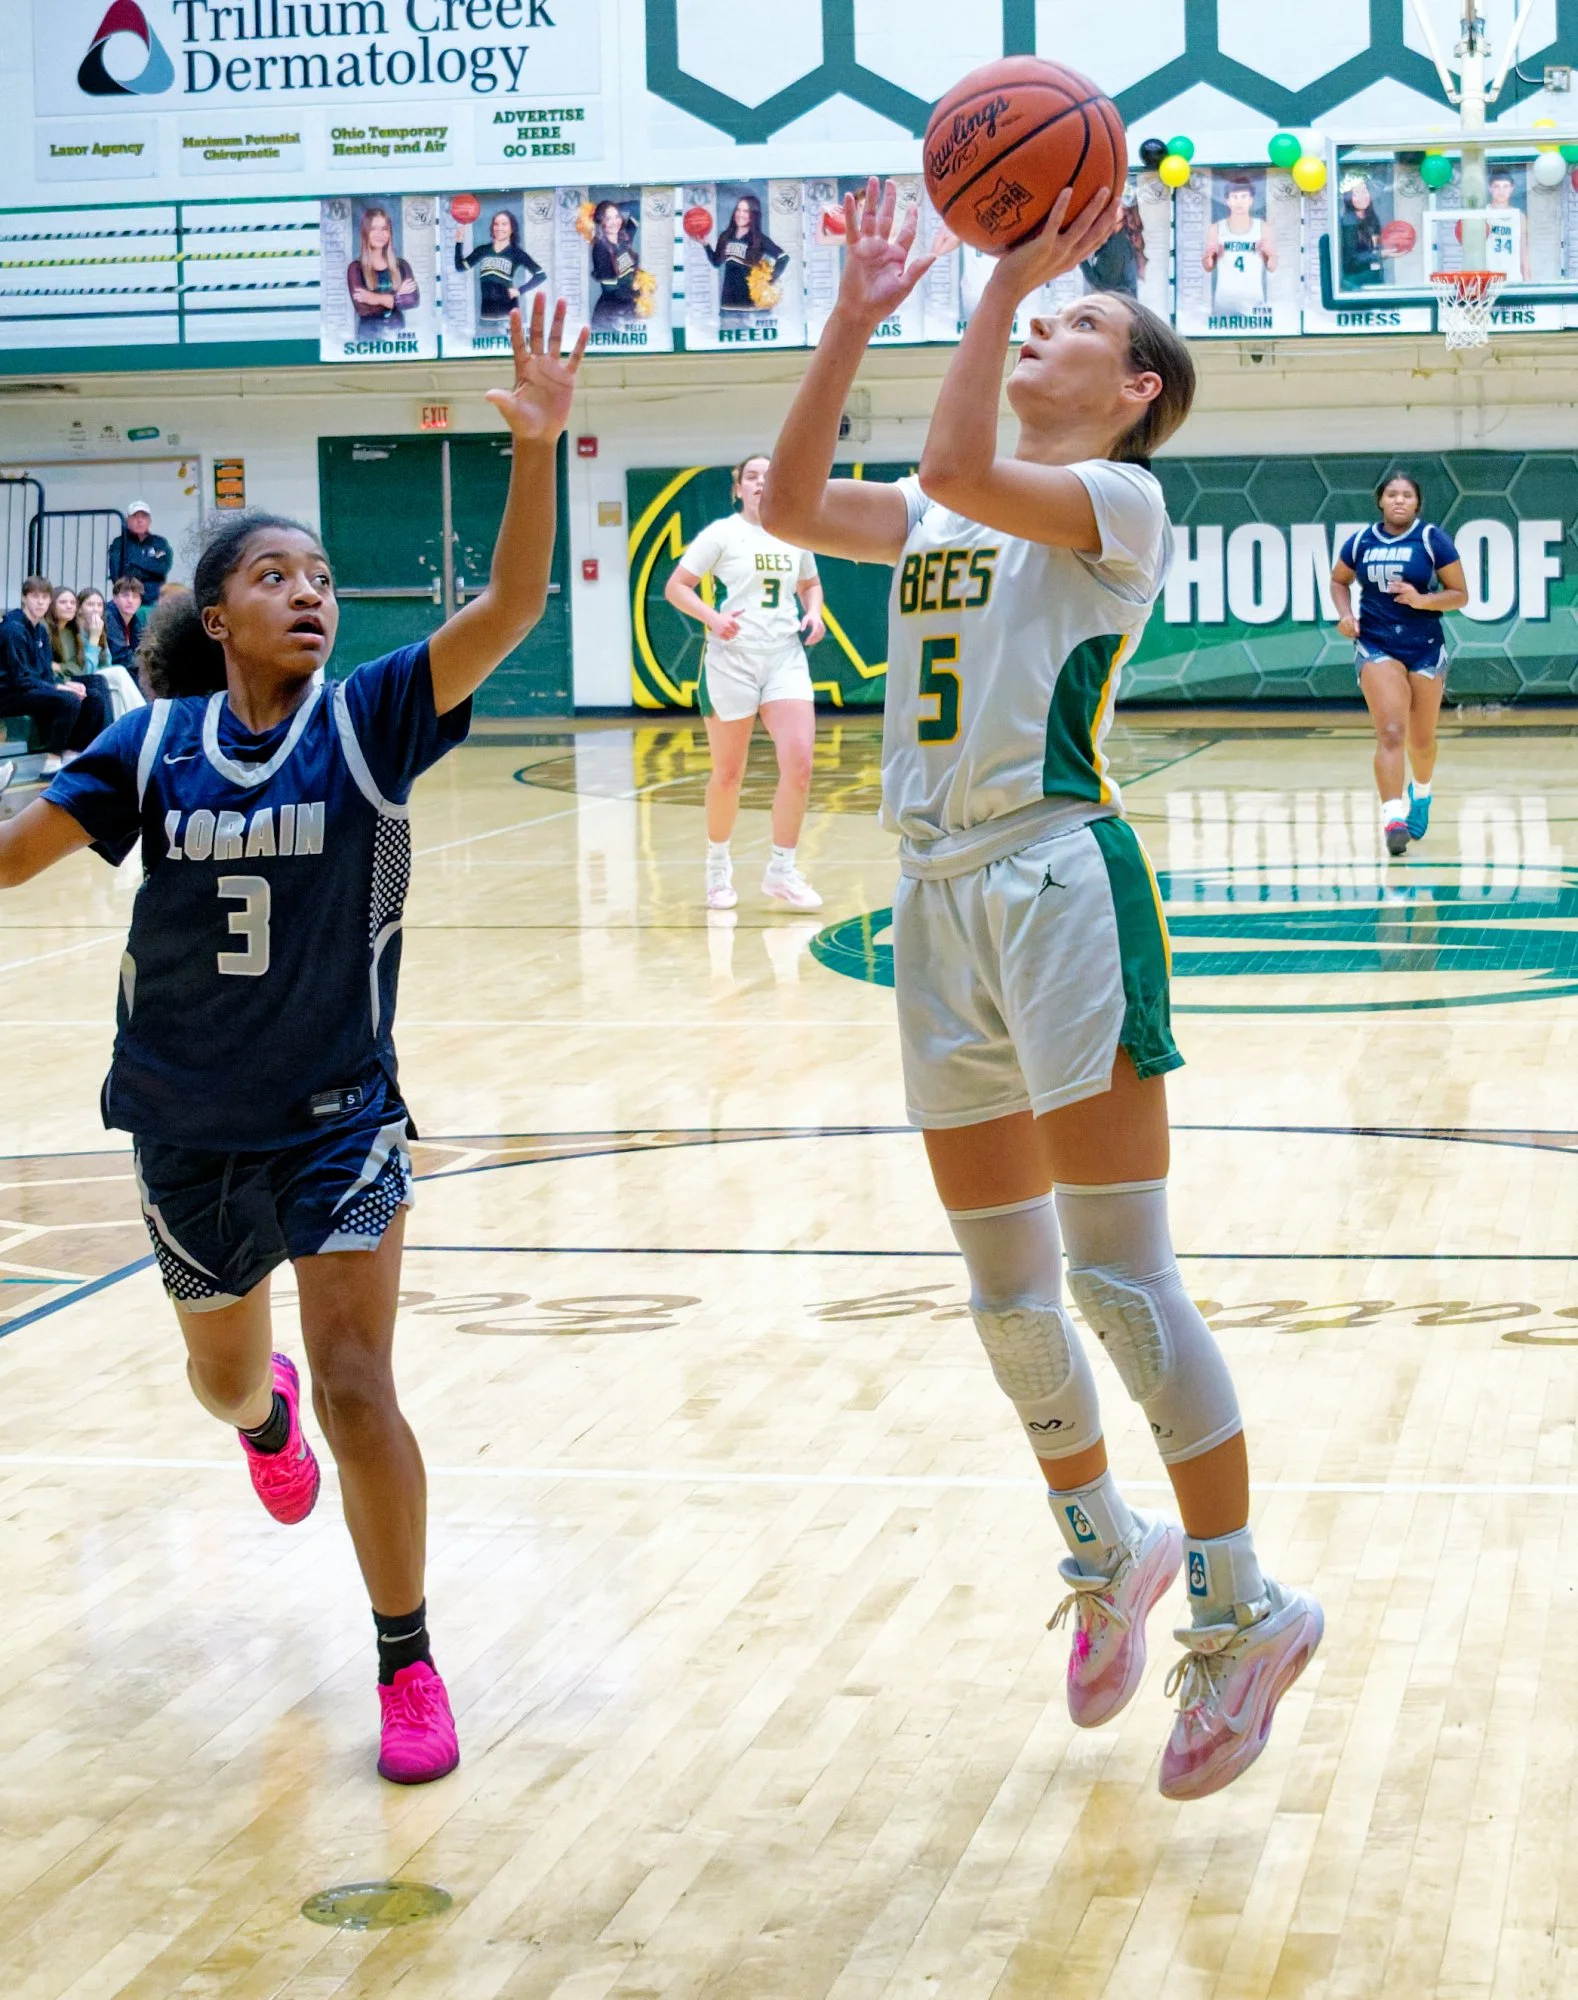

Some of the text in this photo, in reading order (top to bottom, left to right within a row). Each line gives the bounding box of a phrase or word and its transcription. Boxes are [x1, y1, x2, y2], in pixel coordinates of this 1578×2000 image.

[172, 0, 556, 42] Trillium Creek
[182, 36, 530, 94] Dermatology
[493, 108, 585, 125] ADVERTISE
[182, 132, 301, 149] Maximum Potential
[331, 126, 449, 141] Ohio Temporary
[517, 126, 561, 140] HERE
[929, 96, 1010, 181] Rawlings
[91, 142, 145, 157] Agency
[203, 147, 281, 161] Chiropractic
[333, 140, 447, 157] Heating and Air
[503, 143, 576, 158] GO BEES!
[1224, 241, 1257, 252] MEDINA
[1494, 238, 1512, 255] 34
[1234, 255, 1245, 272] 4
[1336, 313, 1401, 327] DRESS
[1490, 311, 1536, 325] YERS
[719, 328, 778, 343] REED
[344, 340, 419, 355] SCHORK
[422, 406, 449, 428] EXIT
[755, 553, 793, 572] BEES
[1163, 518, 1565, 624] HOM OF
[900, 545, 1000, 616] BEES
[761, 578, 781, 609] 3
[917, 632, 963, 747] 5
[164, 801, 326, 861] LORAIN
[217, 875, 271, 977] 3
[346, 1094, 356, 1105] S
